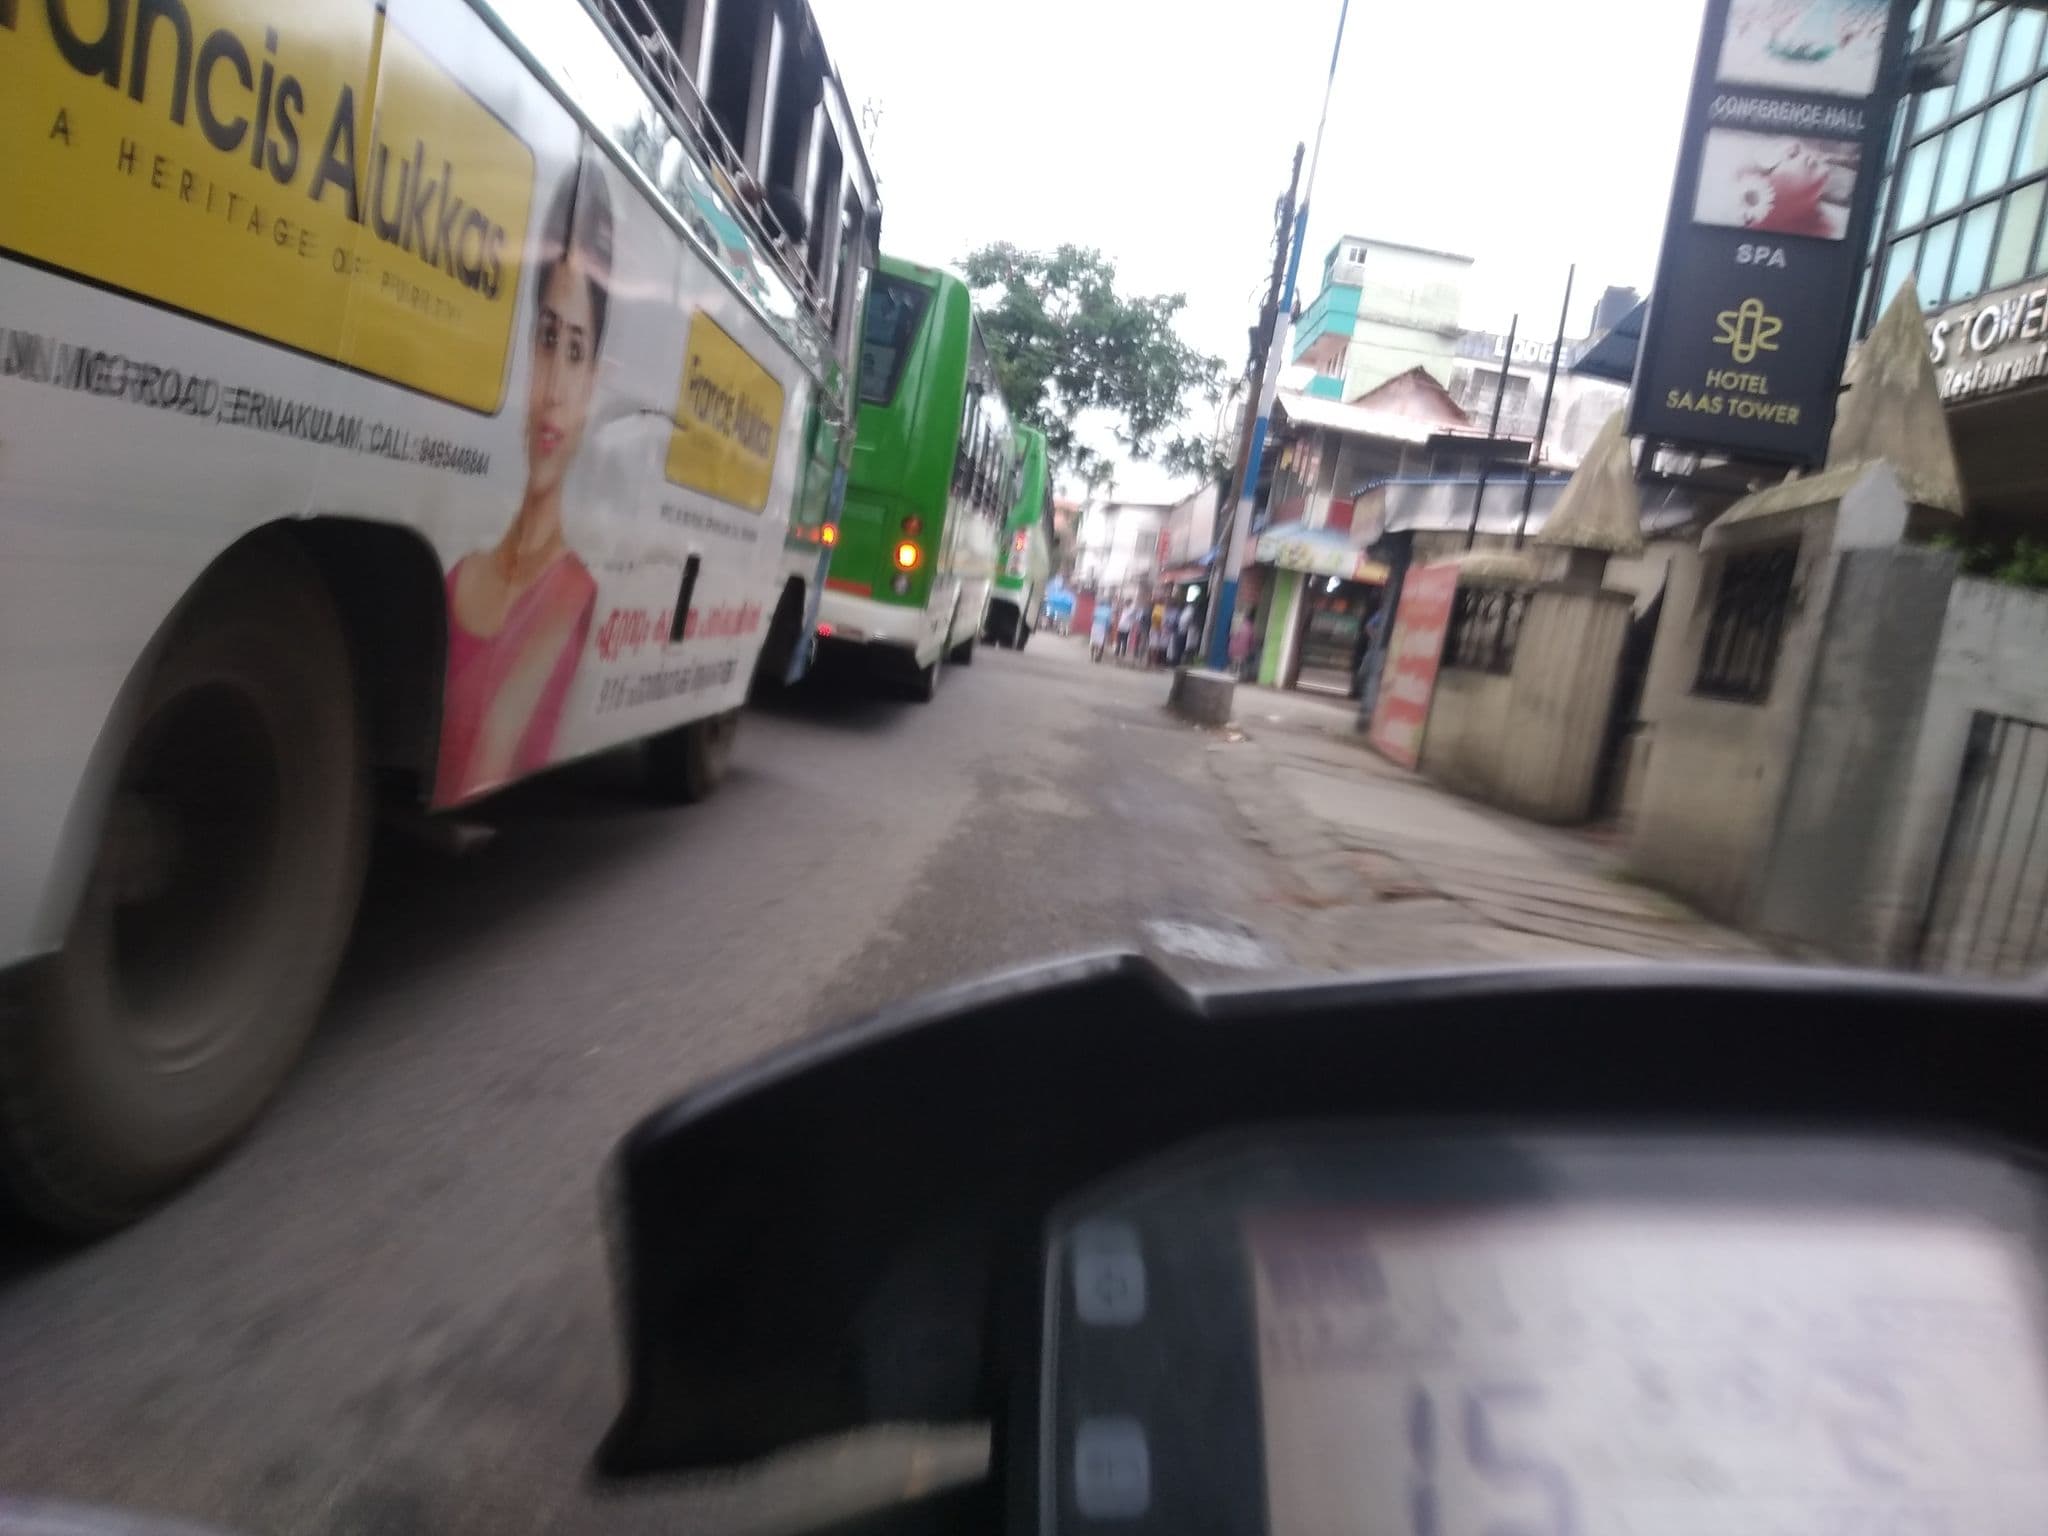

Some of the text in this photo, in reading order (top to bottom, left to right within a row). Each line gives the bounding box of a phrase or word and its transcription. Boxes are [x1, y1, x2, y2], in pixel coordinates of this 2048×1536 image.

[1711, 95, 1865, 131] CONFERENCE HALL
[50, 108, 71, 146] A
[117, 137, 322, 258] HERITAGE
[1736, 244, 1787, 268] SPA
[1957, 288, 2048, 355] TOWE
[1706, 368, 1768, 395] HOTEL
[1666, 389, 1799, 425] SAAS TOWER
